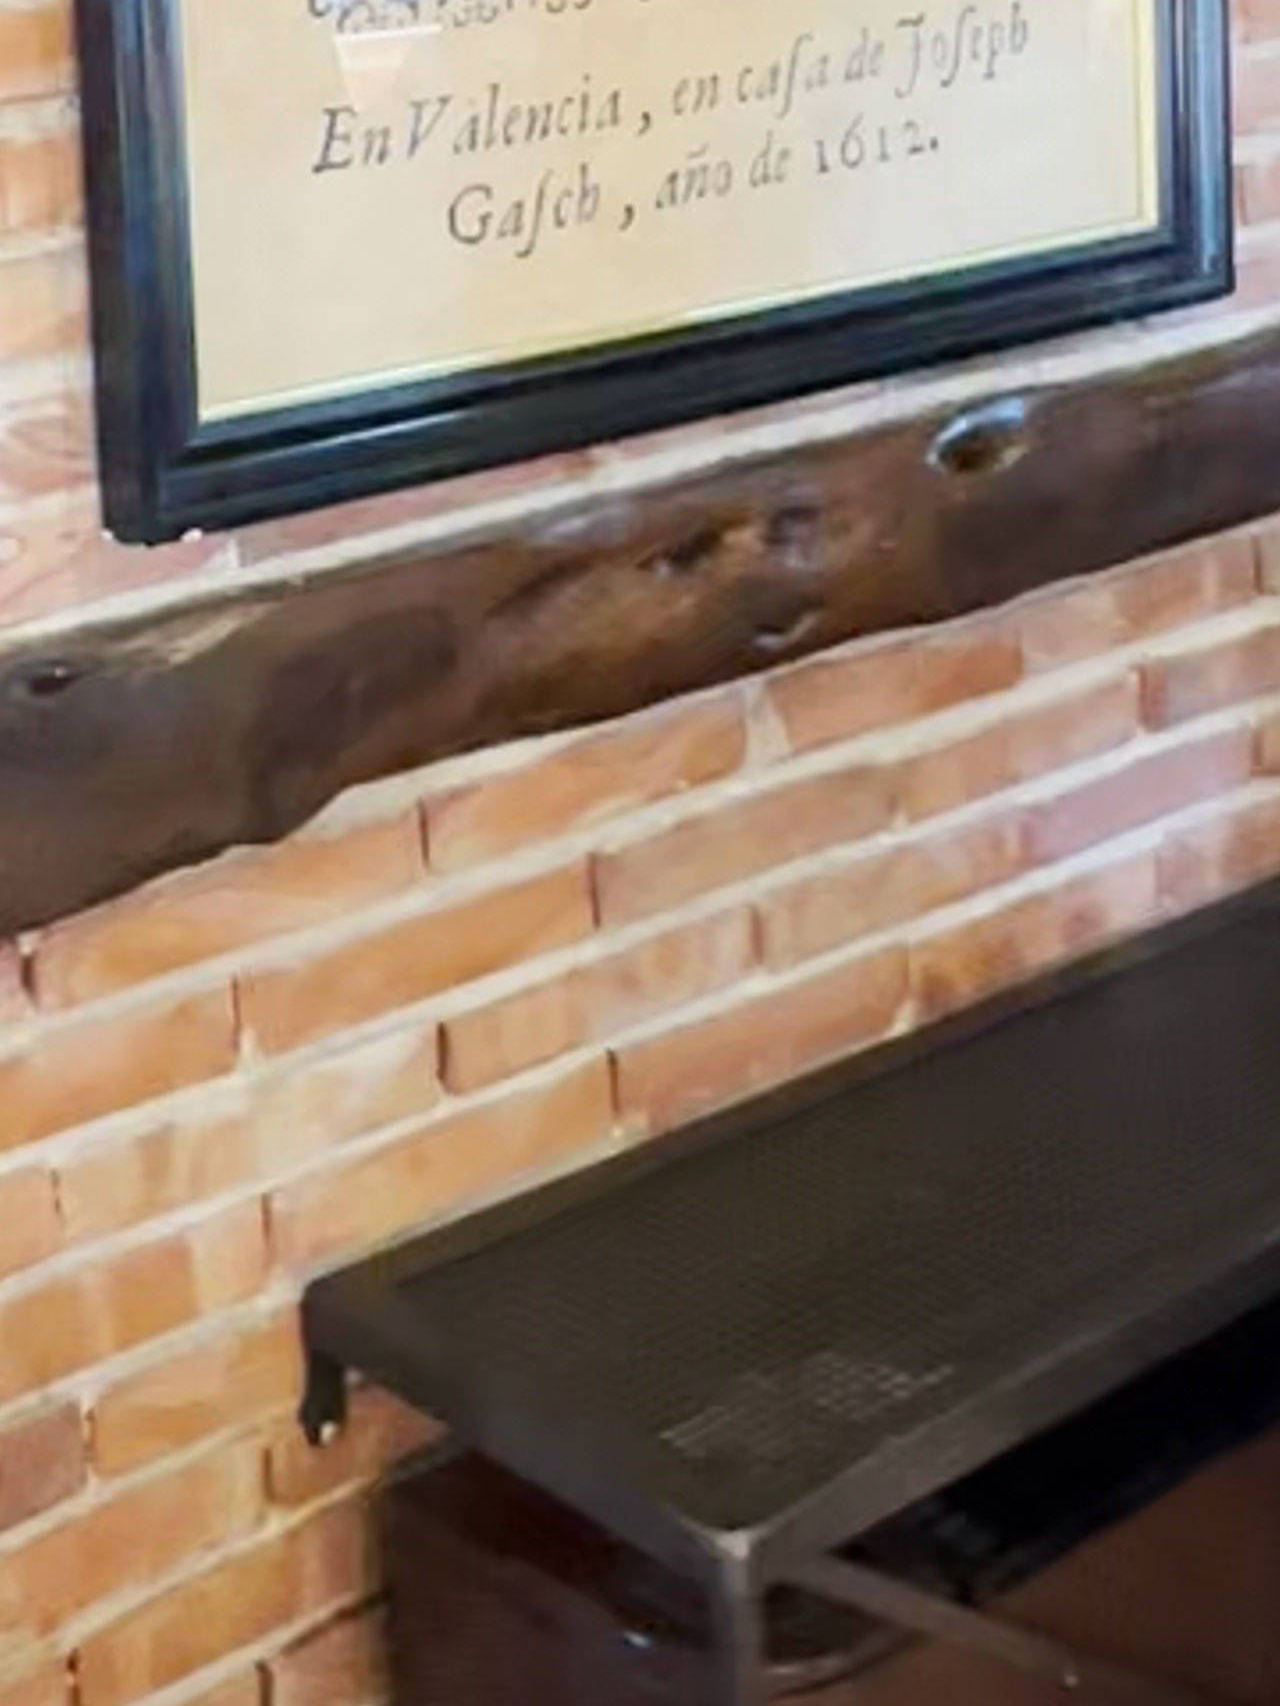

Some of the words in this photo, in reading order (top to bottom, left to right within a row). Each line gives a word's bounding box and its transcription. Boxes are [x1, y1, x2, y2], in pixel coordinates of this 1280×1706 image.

[311, 105, 392, 173] En
[671, 70, 720, 117] en
[843, 26, 887, 83] de
[654, 142, 733, 210] año
[748, 128, 792, 188] de
